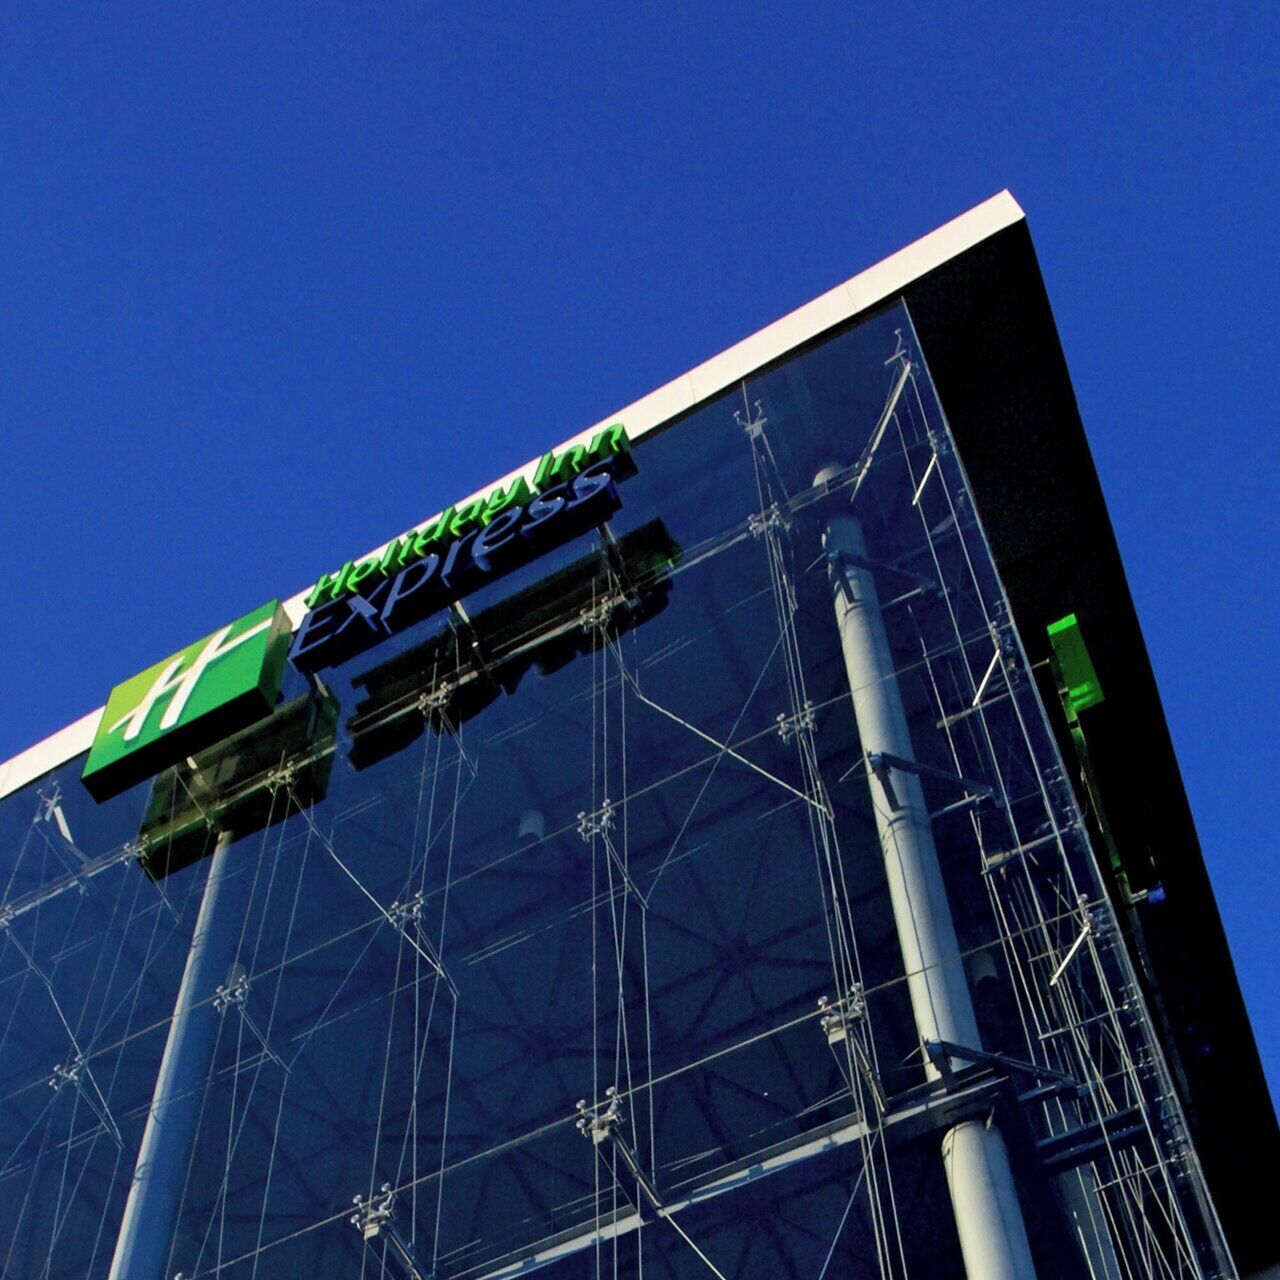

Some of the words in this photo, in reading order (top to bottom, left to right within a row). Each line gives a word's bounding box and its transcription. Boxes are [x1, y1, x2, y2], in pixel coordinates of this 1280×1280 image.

[287, 455, 619, 666] Express
[304, 475, 530, 608] Holiday
[532, 422, 631, 494] Inn
[108, 614, 274, 741] H
